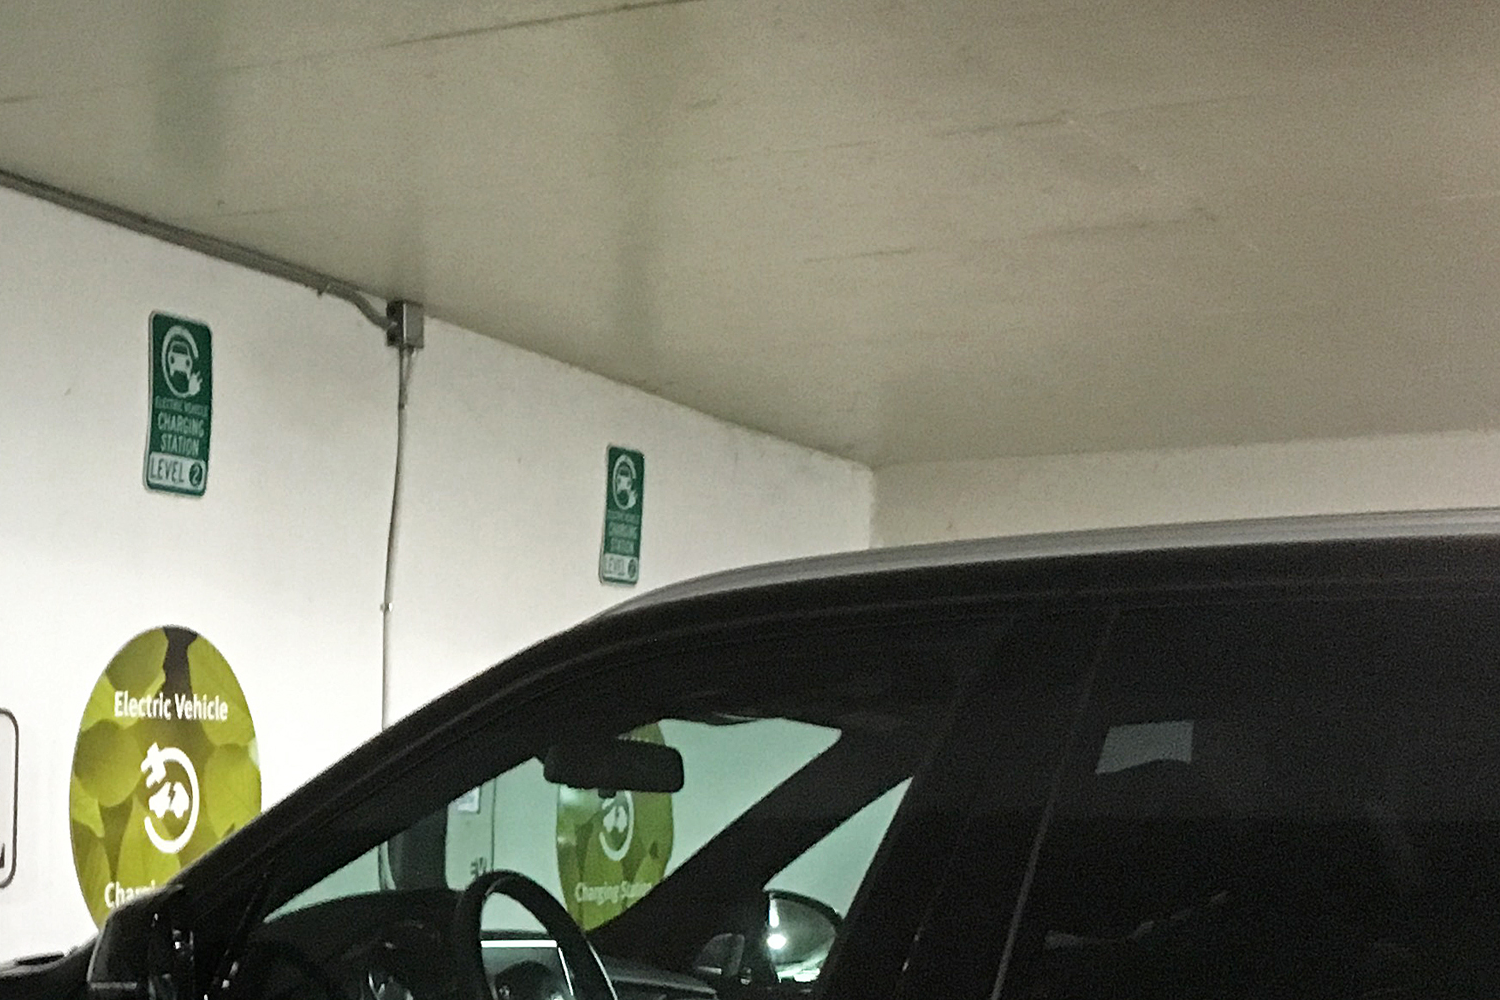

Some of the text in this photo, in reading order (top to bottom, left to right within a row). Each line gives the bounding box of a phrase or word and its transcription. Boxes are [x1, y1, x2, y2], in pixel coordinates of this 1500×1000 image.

[157, 412, 205, 438] CHARGING
[160, 433, 201, 458] STATION
[150, 456, 184, 483] LEVEL
[114, 690, 229, 721] Electric Vehicle
